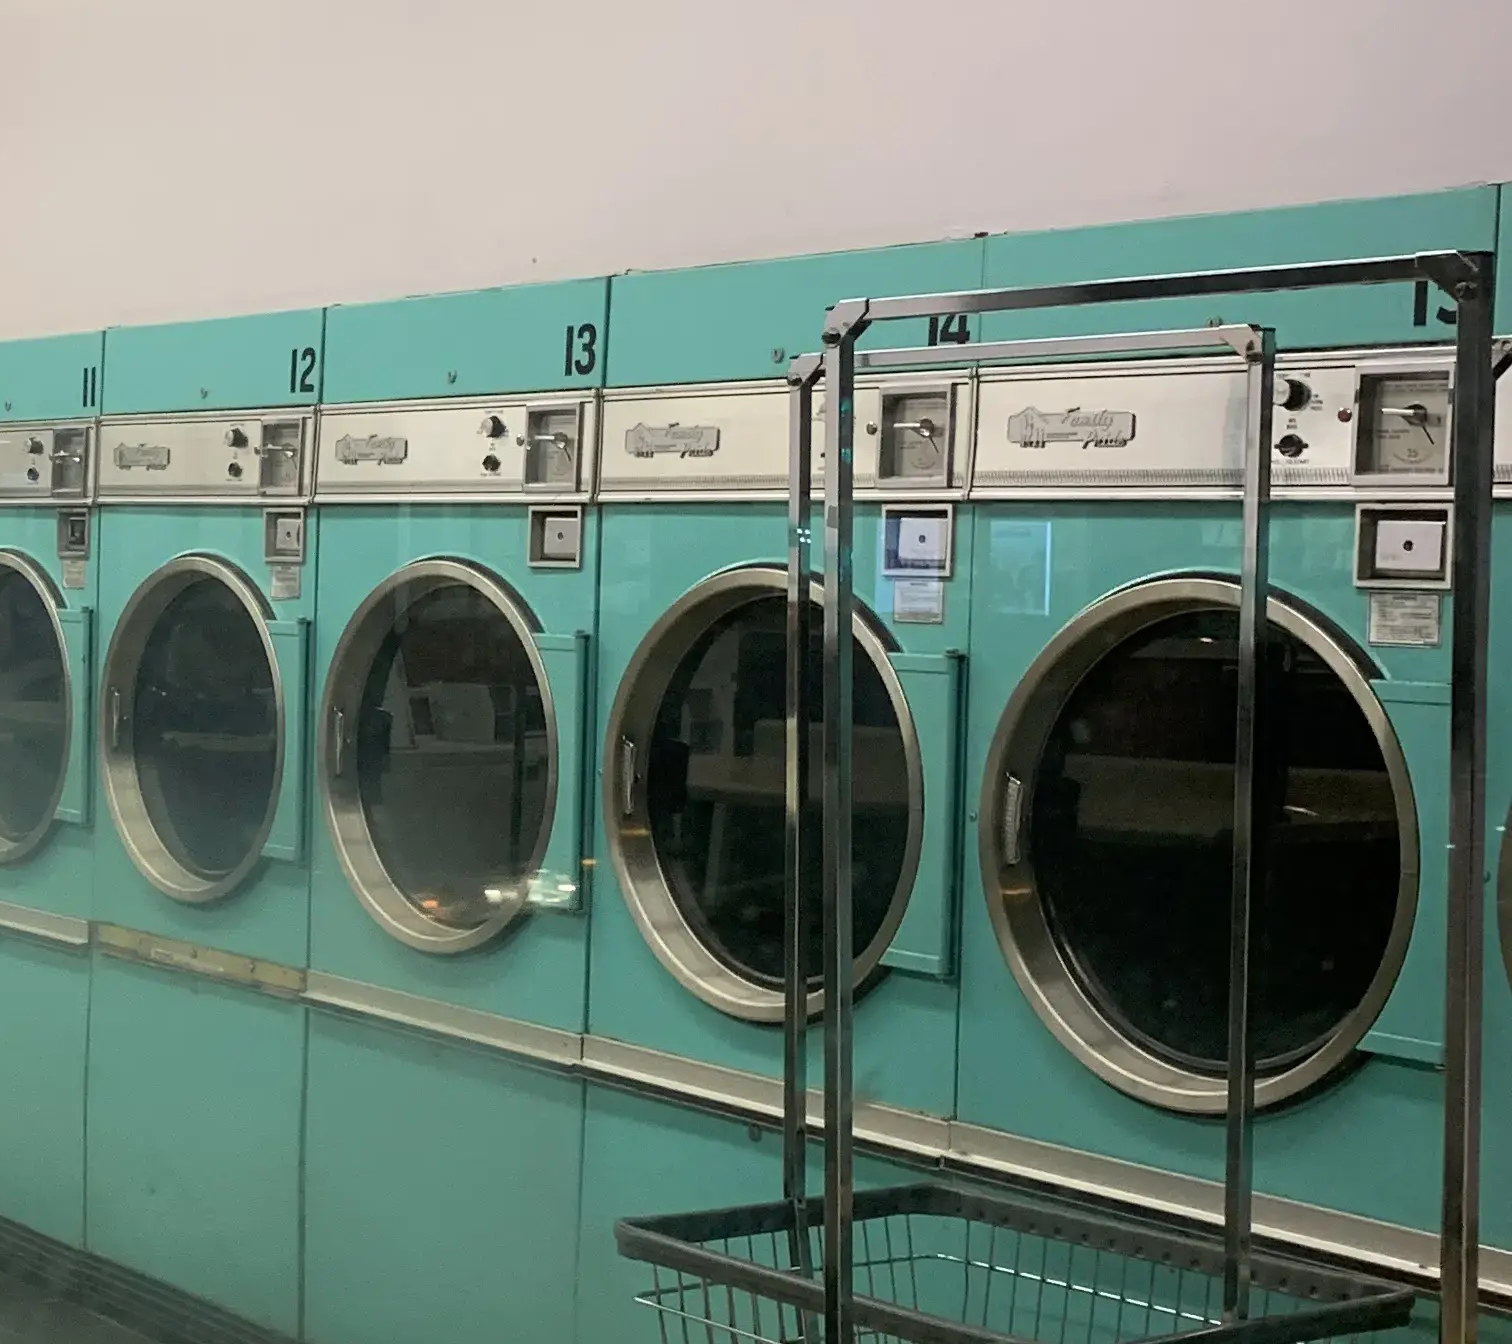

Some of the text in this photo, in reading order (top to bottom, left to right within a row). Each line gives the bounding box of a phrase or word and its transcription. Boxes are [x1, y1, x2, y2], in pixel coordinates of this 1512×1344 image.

[1413, 280, 1457, 327] 1
[564, 323, 597, 376] 13
[928, 312, 970, 346] 14
[82, 366, 97, 408] 11
[290, 346, 316, 394] 12
